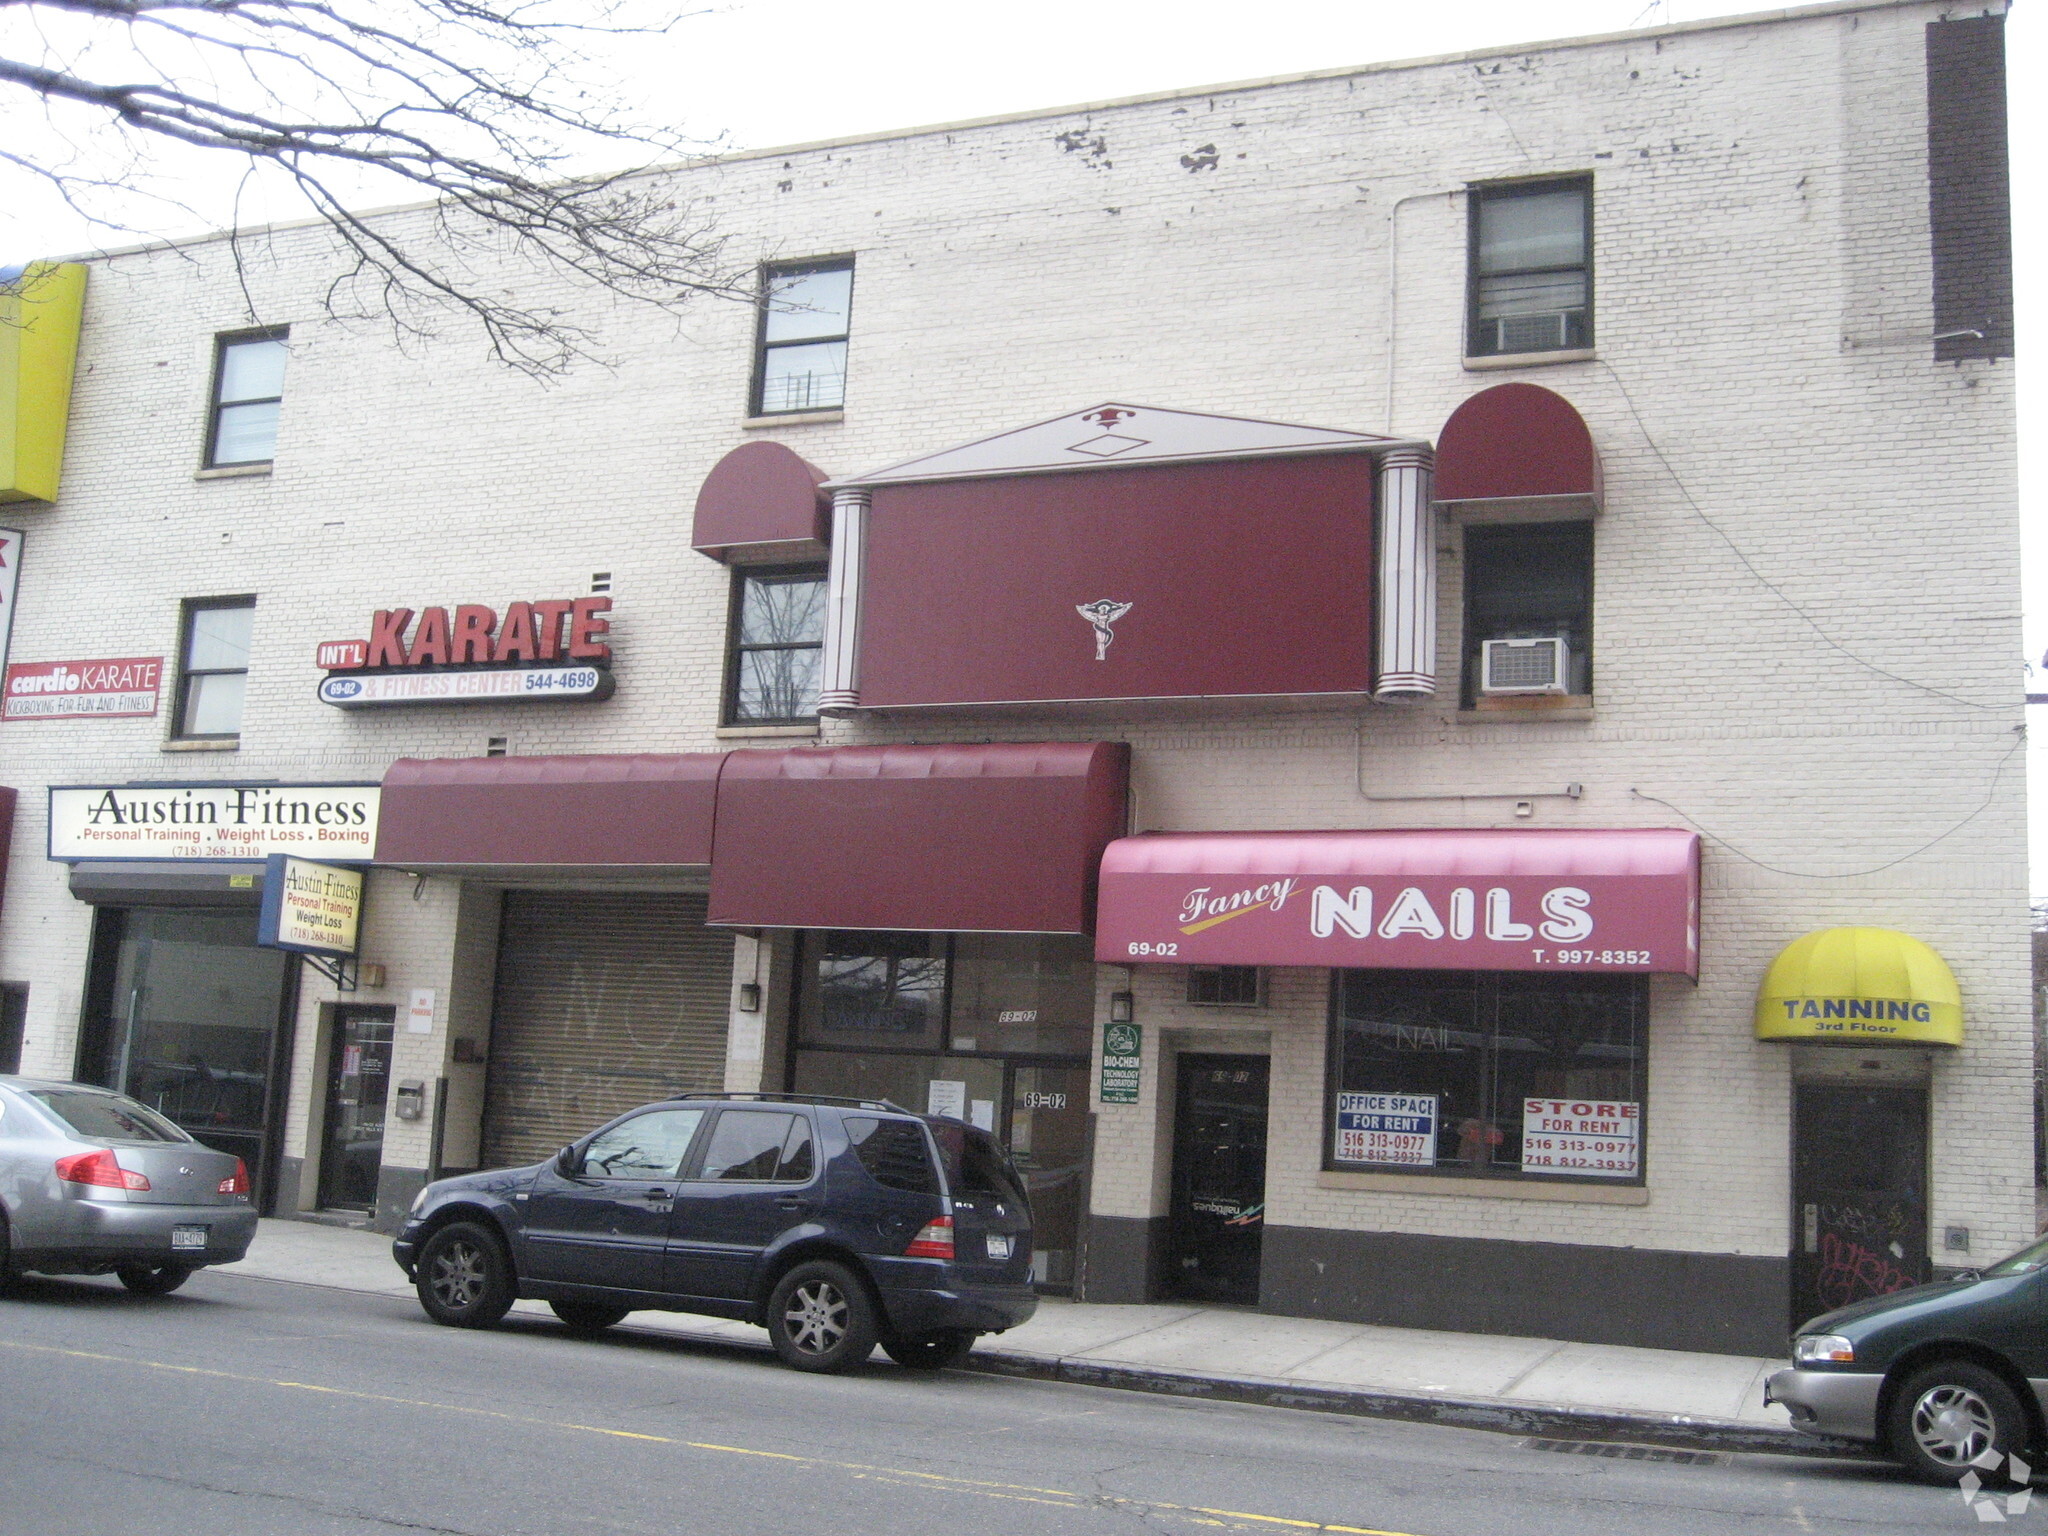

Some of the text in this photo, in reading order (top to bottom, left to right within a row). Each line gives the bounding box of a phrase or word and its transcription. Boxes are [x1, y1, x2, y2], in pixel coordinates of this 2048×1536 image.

[320, 596, 613, 668] INT'L KARATE
[329, 671, 596, 697] 69-02 & FITNESS CENTER 544-4698
[6, 698, 54, 715] KICKBOXING
[58, 696, 74, 712] FOR
[77, 695, 95, 712] FUN
[96, 695, 115, 711] AND
[88, 788, 367, 825] Austin Fitness
[83, 828, 370, 844] Personal Training Weight Loss Boxing
[171, 846, 260, 858] (718) 268-1310
[286, 866, 322, 895] Austin
[324, 873, 360, 902] Fitness
[287, 892, 353, 918] Personal Training
[1179, 877, 1594, 943] Fancy NAILS
[296, 909, 343, 929] Weight Loss
[290, 927, 344, 945] (718) 268-1310
[1128, 942, 1178, 956] 69-02
[1533, 949, 1651, 965] T. 997-8352
[1000, 1011, 1035, 1022] 69-02
[1783, 999, 1931, 1023] TANNING
[1815, 1023, 1897, 1034] 3rd Floor
[1103, 1056, 1140, 1068] BIO-CHEM
[1103, 1070, 1139, 1079] TECHNOLOGY
[1103, 1079, 1138, 1087] LABORATORY
[1025, 1092, 1065, 1109] 69-02
[1340, 1095, 1433, 1115] OFFICE SPACE
[1526, 1101, 1638, 1119] STORE
[1352, 1115, 1420, 1131] FOR RENT
[1542, 1119, 1621, 1134] FOR RENT
[1344, 1132, 1425, 1150] 516 313-0977
[1525, 1138, 1637, 1154] 516 313-0977
[1344, 1148, 1423, 1164] 718 812-3937
[1525, 1155, 1637, 1172] 718 812-3937
